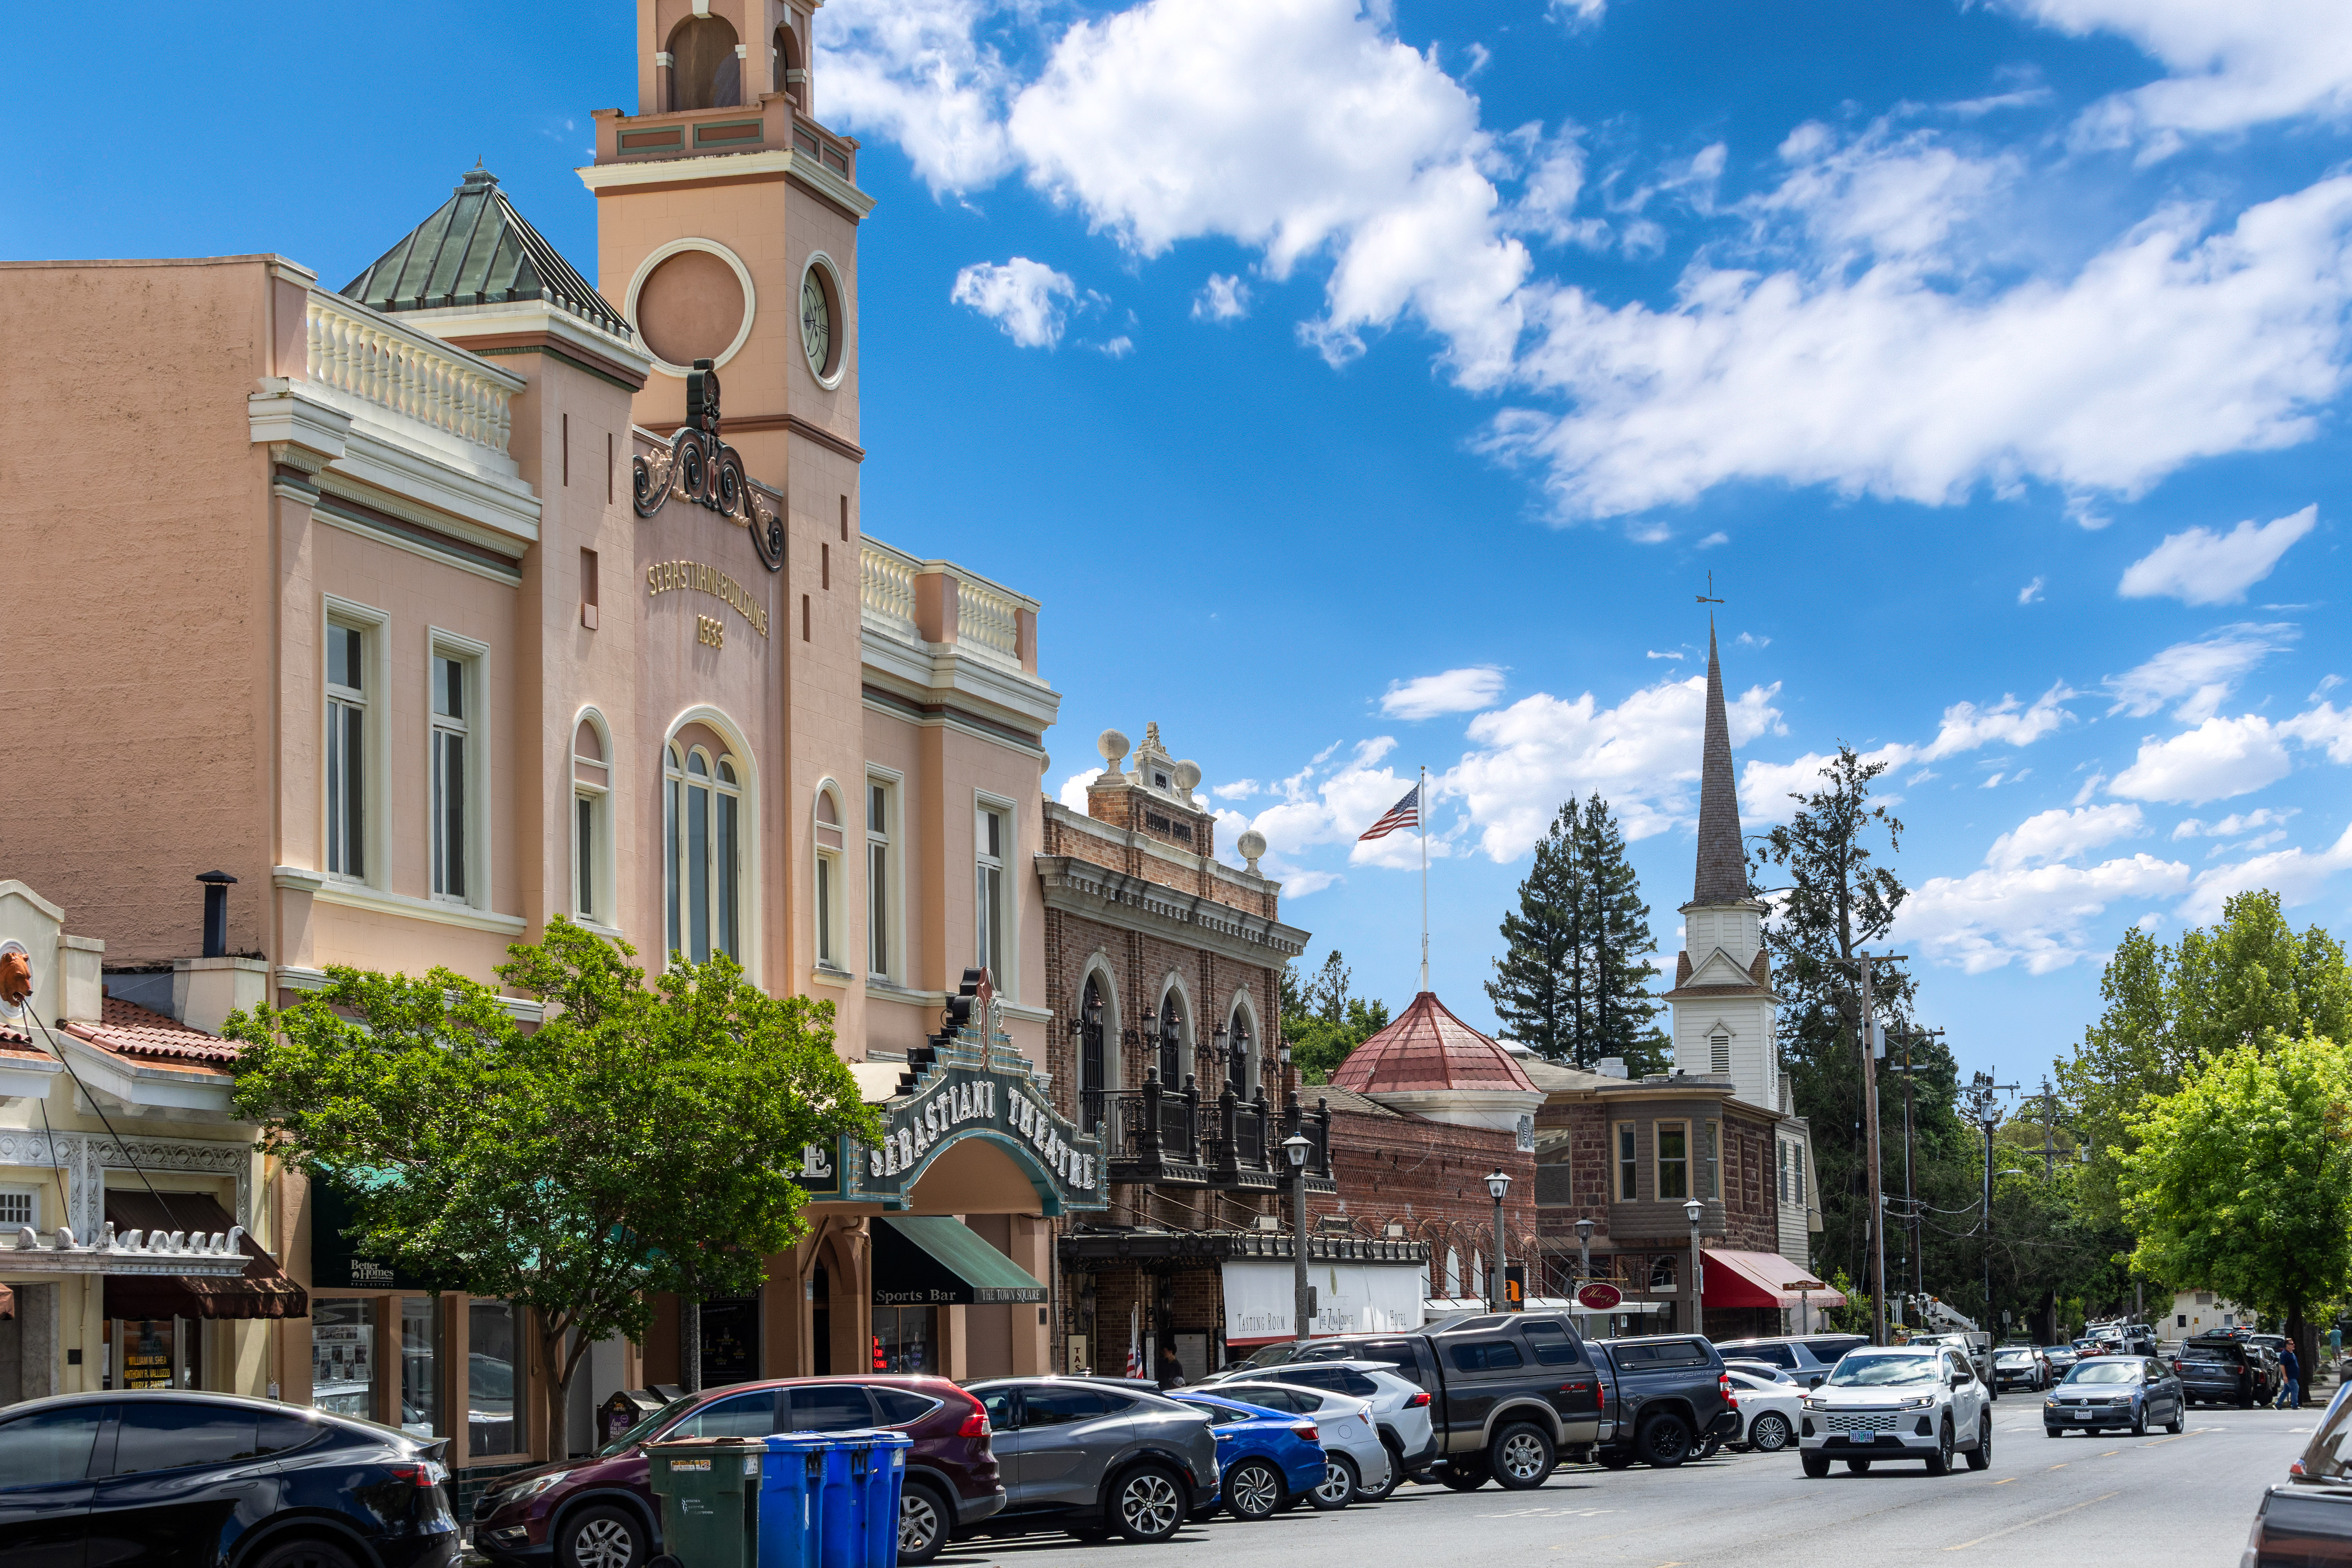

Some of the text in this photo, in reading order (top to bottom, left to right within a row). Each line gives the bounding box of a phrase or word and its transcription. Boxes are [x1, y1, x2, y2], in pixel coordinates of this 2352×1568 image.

[698, 614, 724, 649] 1933
[870, 1081, 1096, 1189] SEBASTIANI THEATRE
[351, 1259, 380, 1270] Better
[360, 1269, 394, 1279] Homes
[876, 1289, 956, 1304] Sports Bar
[982, 1289, 1040, 1301] THE TOWN SQUARE
[1238, 1313, 1285, 1331] TASTING ROOM
[1318, 1308, 1353, 1330] THE ZINA LOUNGE
[1390, 1310, 1406, 1326] HOTEL
[129, 1356, 167, 1365] WILLIAM M. SHEA
[124, 1368, 170, 1379] ANTHONY R. VALLUZZO
[131, 1381, 144, 1389] MARY
[150, 1380, 165, 1389] PIASTA
